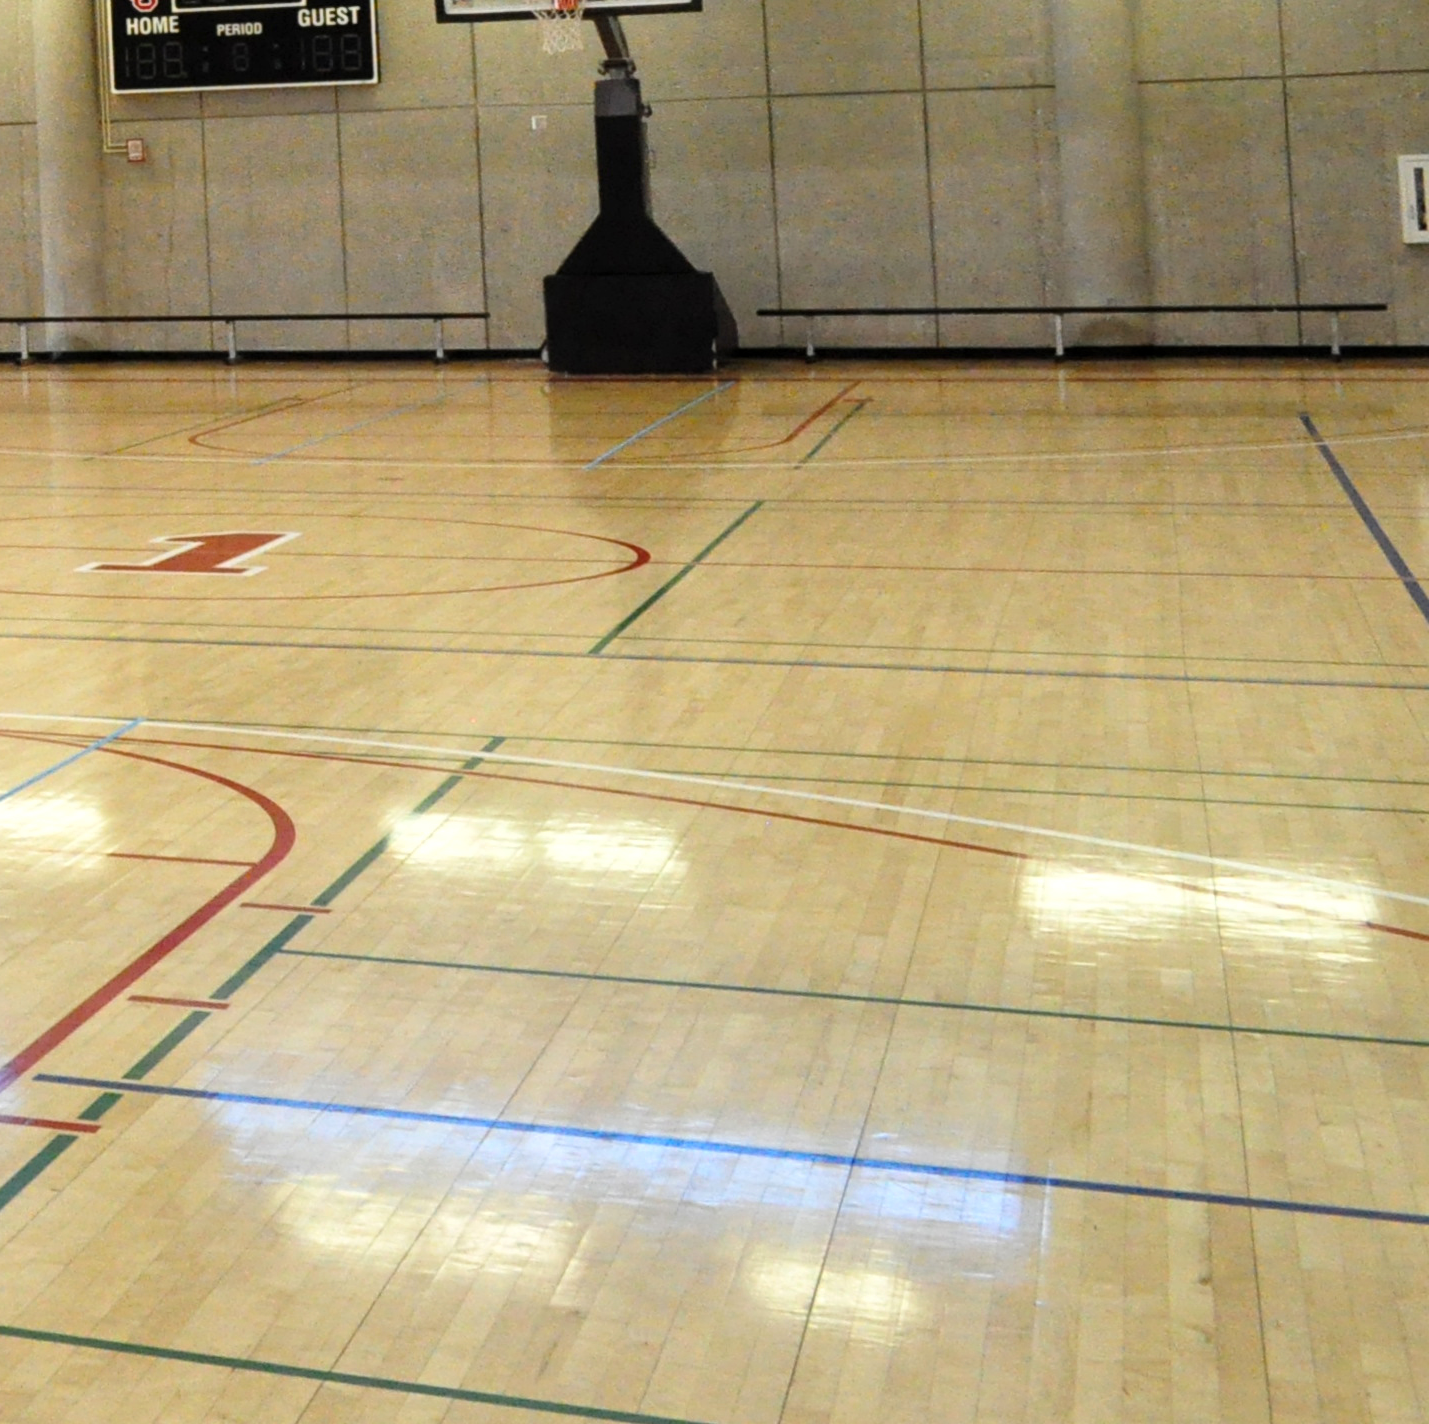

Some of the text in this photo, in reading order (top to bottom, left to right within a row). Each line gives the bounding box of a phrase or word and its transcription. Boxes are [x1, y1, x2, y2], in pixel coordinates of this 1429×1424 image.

[126, 16, 180, 35] HOME
[297, 6, 361, 27] GUEST
[216, 22, 263, 36] PERIOD
[74, 530, 302, 577] 1
